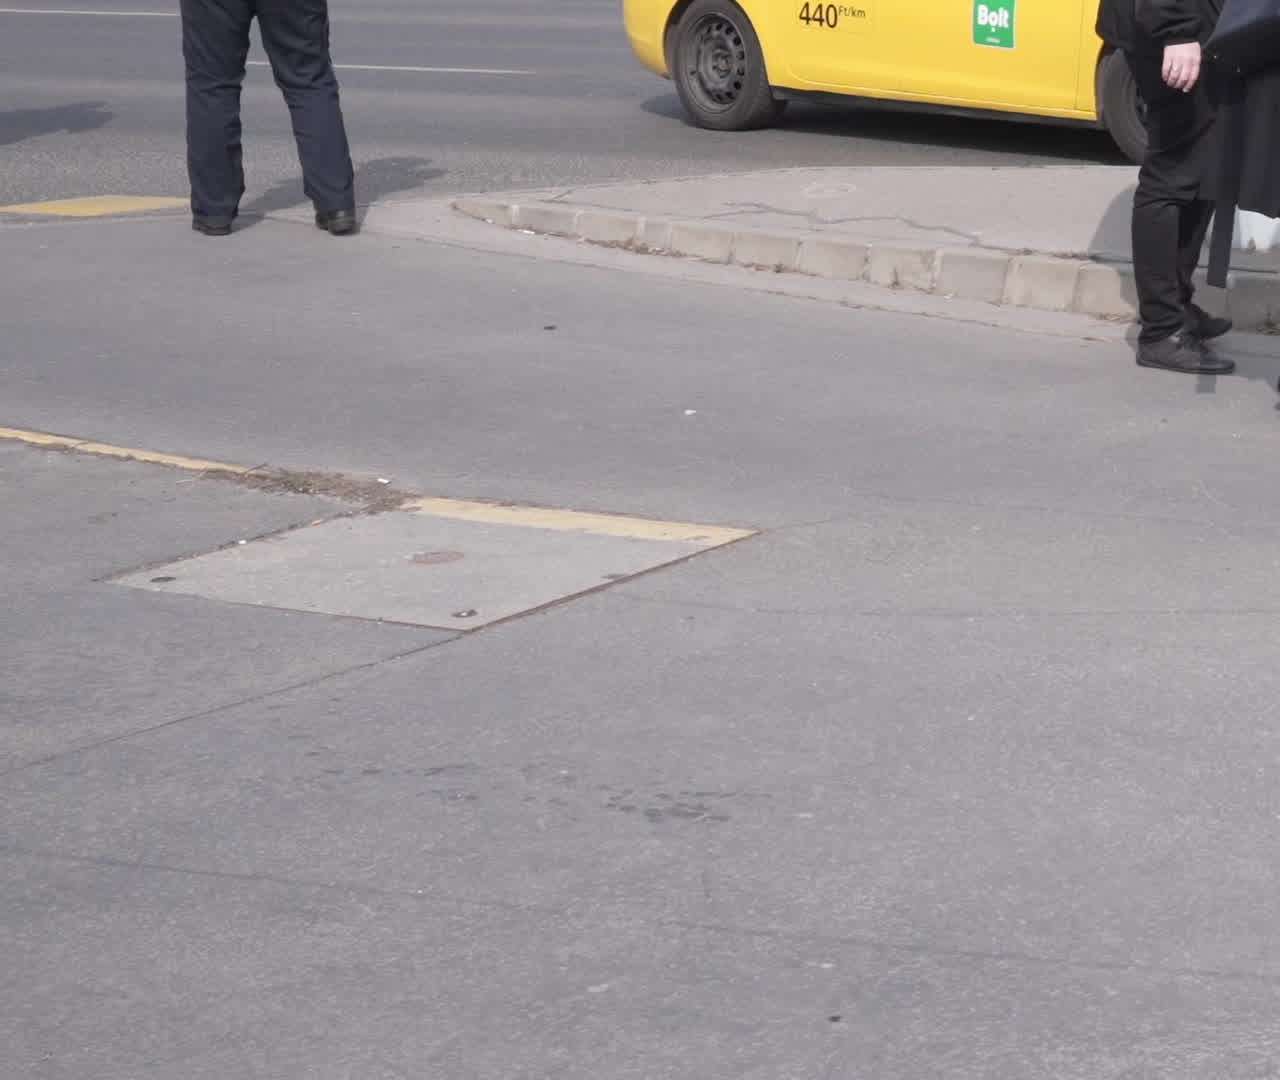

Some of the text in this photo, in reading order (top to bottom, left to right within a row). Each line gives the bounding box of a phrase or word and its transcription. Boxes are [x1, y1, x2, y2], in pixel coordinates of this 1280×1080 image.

[799, 2, 866, 28] 440 Ft/km
[977, 4, 1009, 29] Bolt
